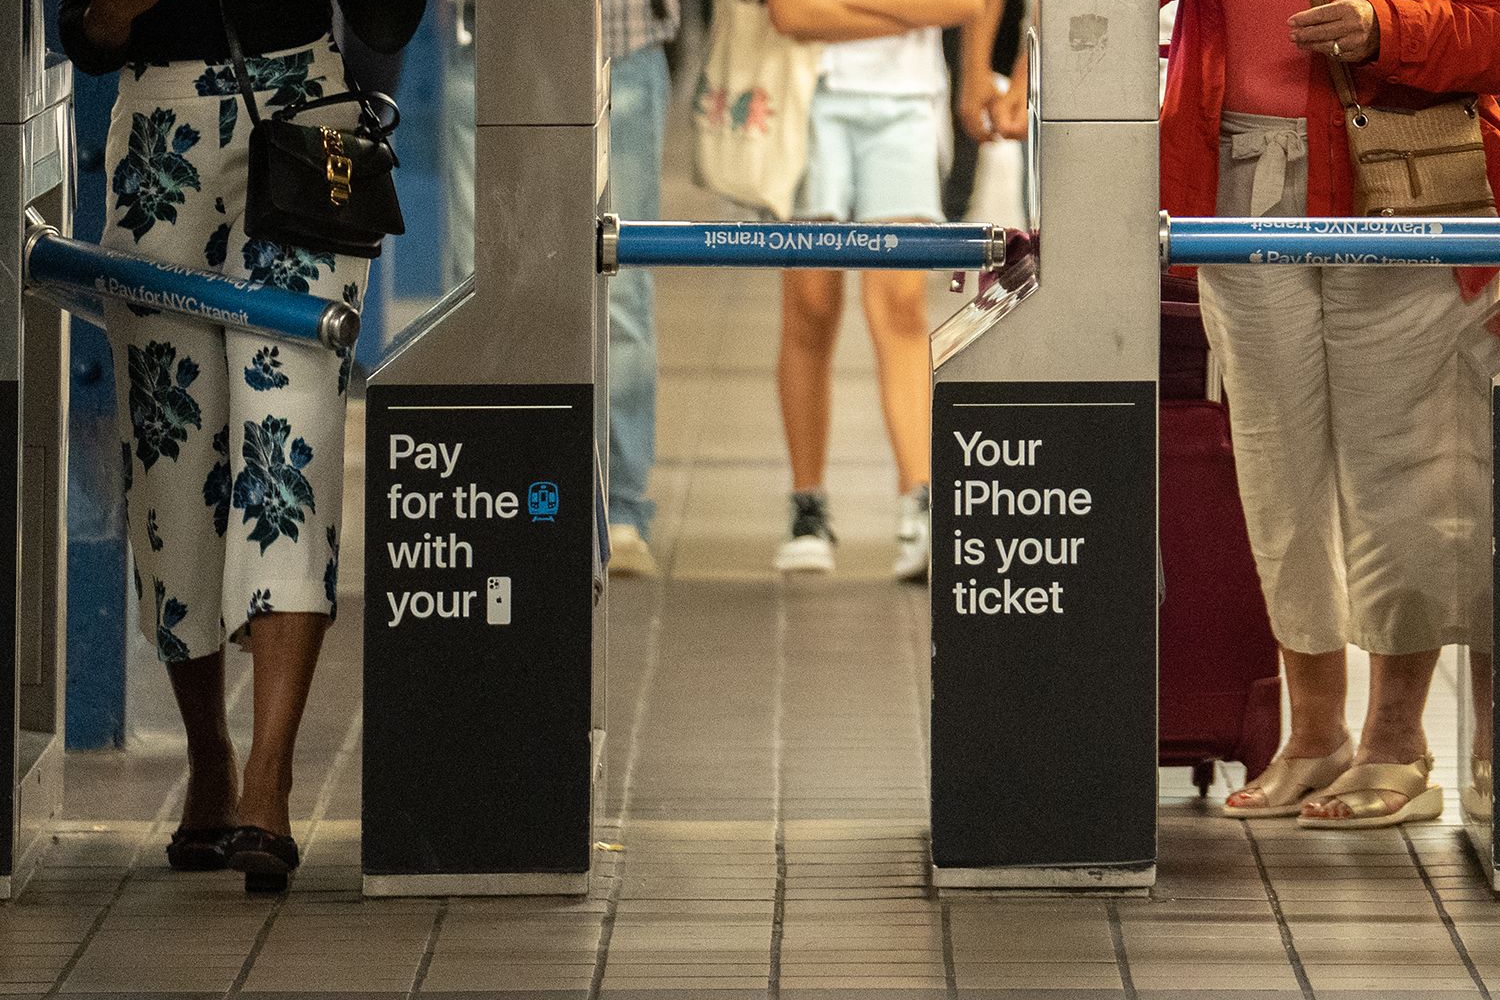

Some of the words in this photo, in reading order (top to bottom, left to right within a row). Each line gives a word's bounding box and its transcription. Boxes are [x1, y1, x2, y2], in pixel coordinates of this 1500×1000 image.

[704, 231, 766, 248] transit
[768, 231, 813, 250] NYC
[815, 232, 843, 250] for
[845, 230, 881, 251] Pay
[1314, 221, 1358, 235] NYC
[1267, 250, 1301, 264] Pay
[1305, 252, 1332, 264] for
[1335, 253, 1378, 264] NYC
[108, 277, 137, 301] Pay
[138, 285, 161, 304] for
[161, 290, 199, 314] NYC
[199, 302, 250, 326] transit
[389, 433, 463, 478] Pay
[953, 430, 1043, 466] Your
[387, 484, 444, 520] for
[452, 483, 520, 519] the
[954, 480, 1093, 516] iPhone
[387, 532, 473, 569] with
[954, 529, 986, 566] is
[995, 537, 1085, 574] your
[386, 590, 478, 628] your
[952, 578, 1064, 615] ticket
